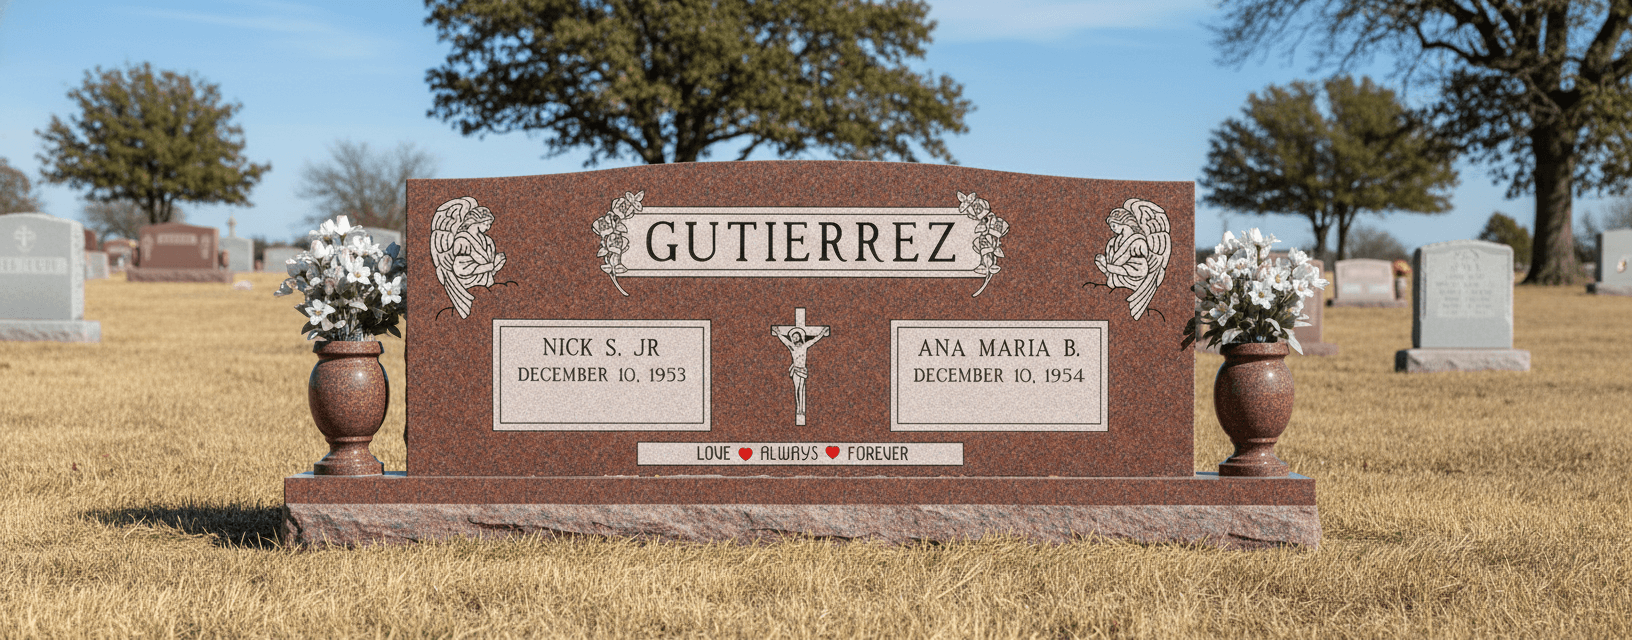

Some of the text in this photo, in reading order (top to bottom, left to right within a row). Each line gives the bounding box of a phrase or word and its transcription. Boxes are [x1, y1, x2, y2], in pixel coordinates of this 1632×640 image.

[646, 221, 957, 263] GUTIERREZ
[542, 337, 660, 357] NICK S. JR
[917, 338, 1080, 357] ANA MARIA B.
[518, 367, 608, 382] DECEMBER
[650, 367, 686, 382] 1953
[913, 367, 1004, 383] DECEMBER
[1045, 368, 1085, 383] 1954
[697, 445, 909, 461] LOVE ALWAYS FOREVER
